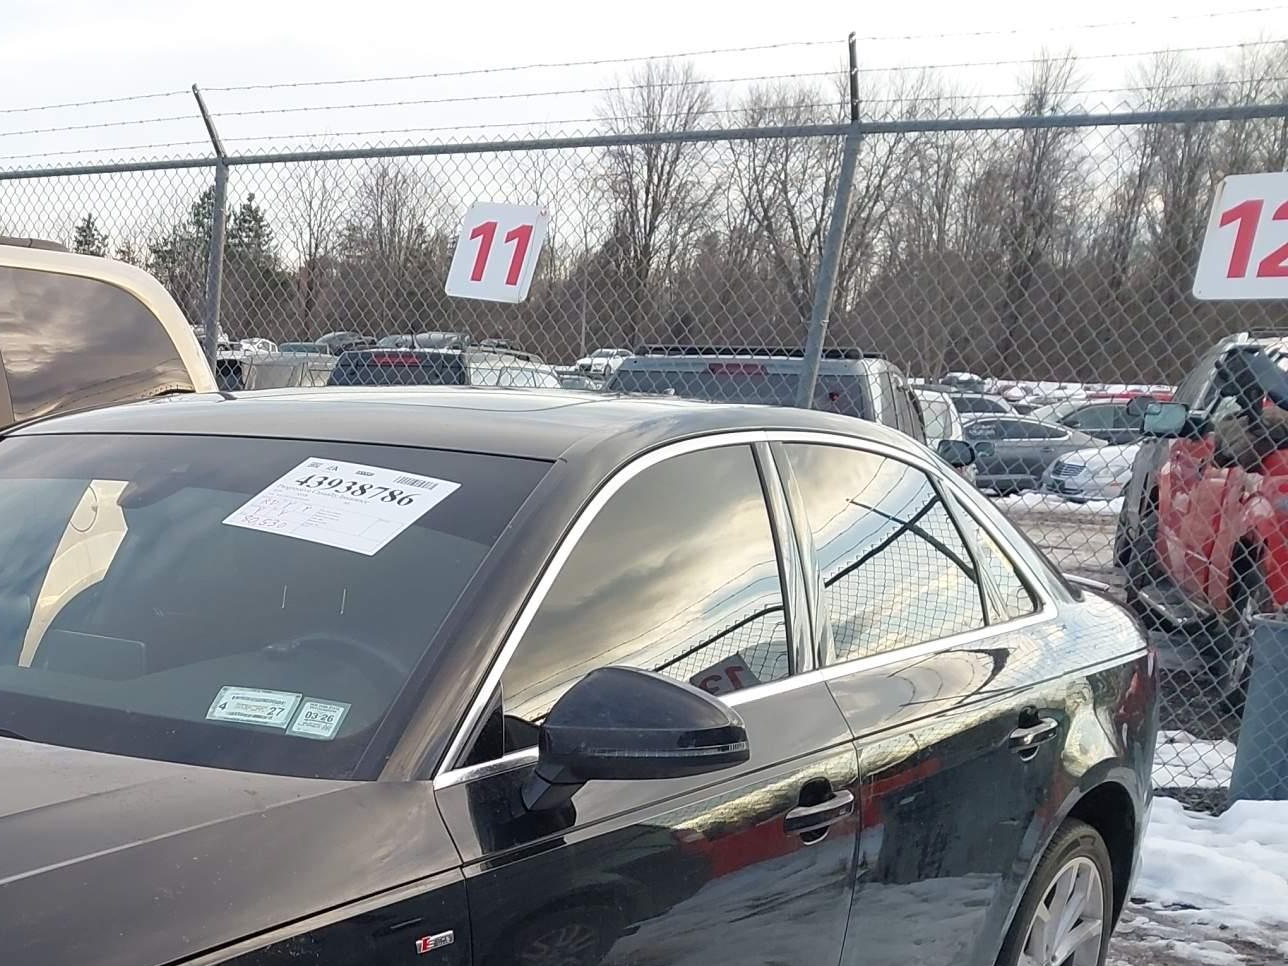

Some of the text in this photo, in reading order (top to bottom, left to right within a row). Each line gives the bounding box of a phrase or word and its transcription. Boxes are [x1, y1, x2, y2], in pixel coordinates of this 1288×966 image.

[469, 220, 534, 286] 11
[295, 474, 421, 507] 43938786
[266, 706, 285, 718] 27
